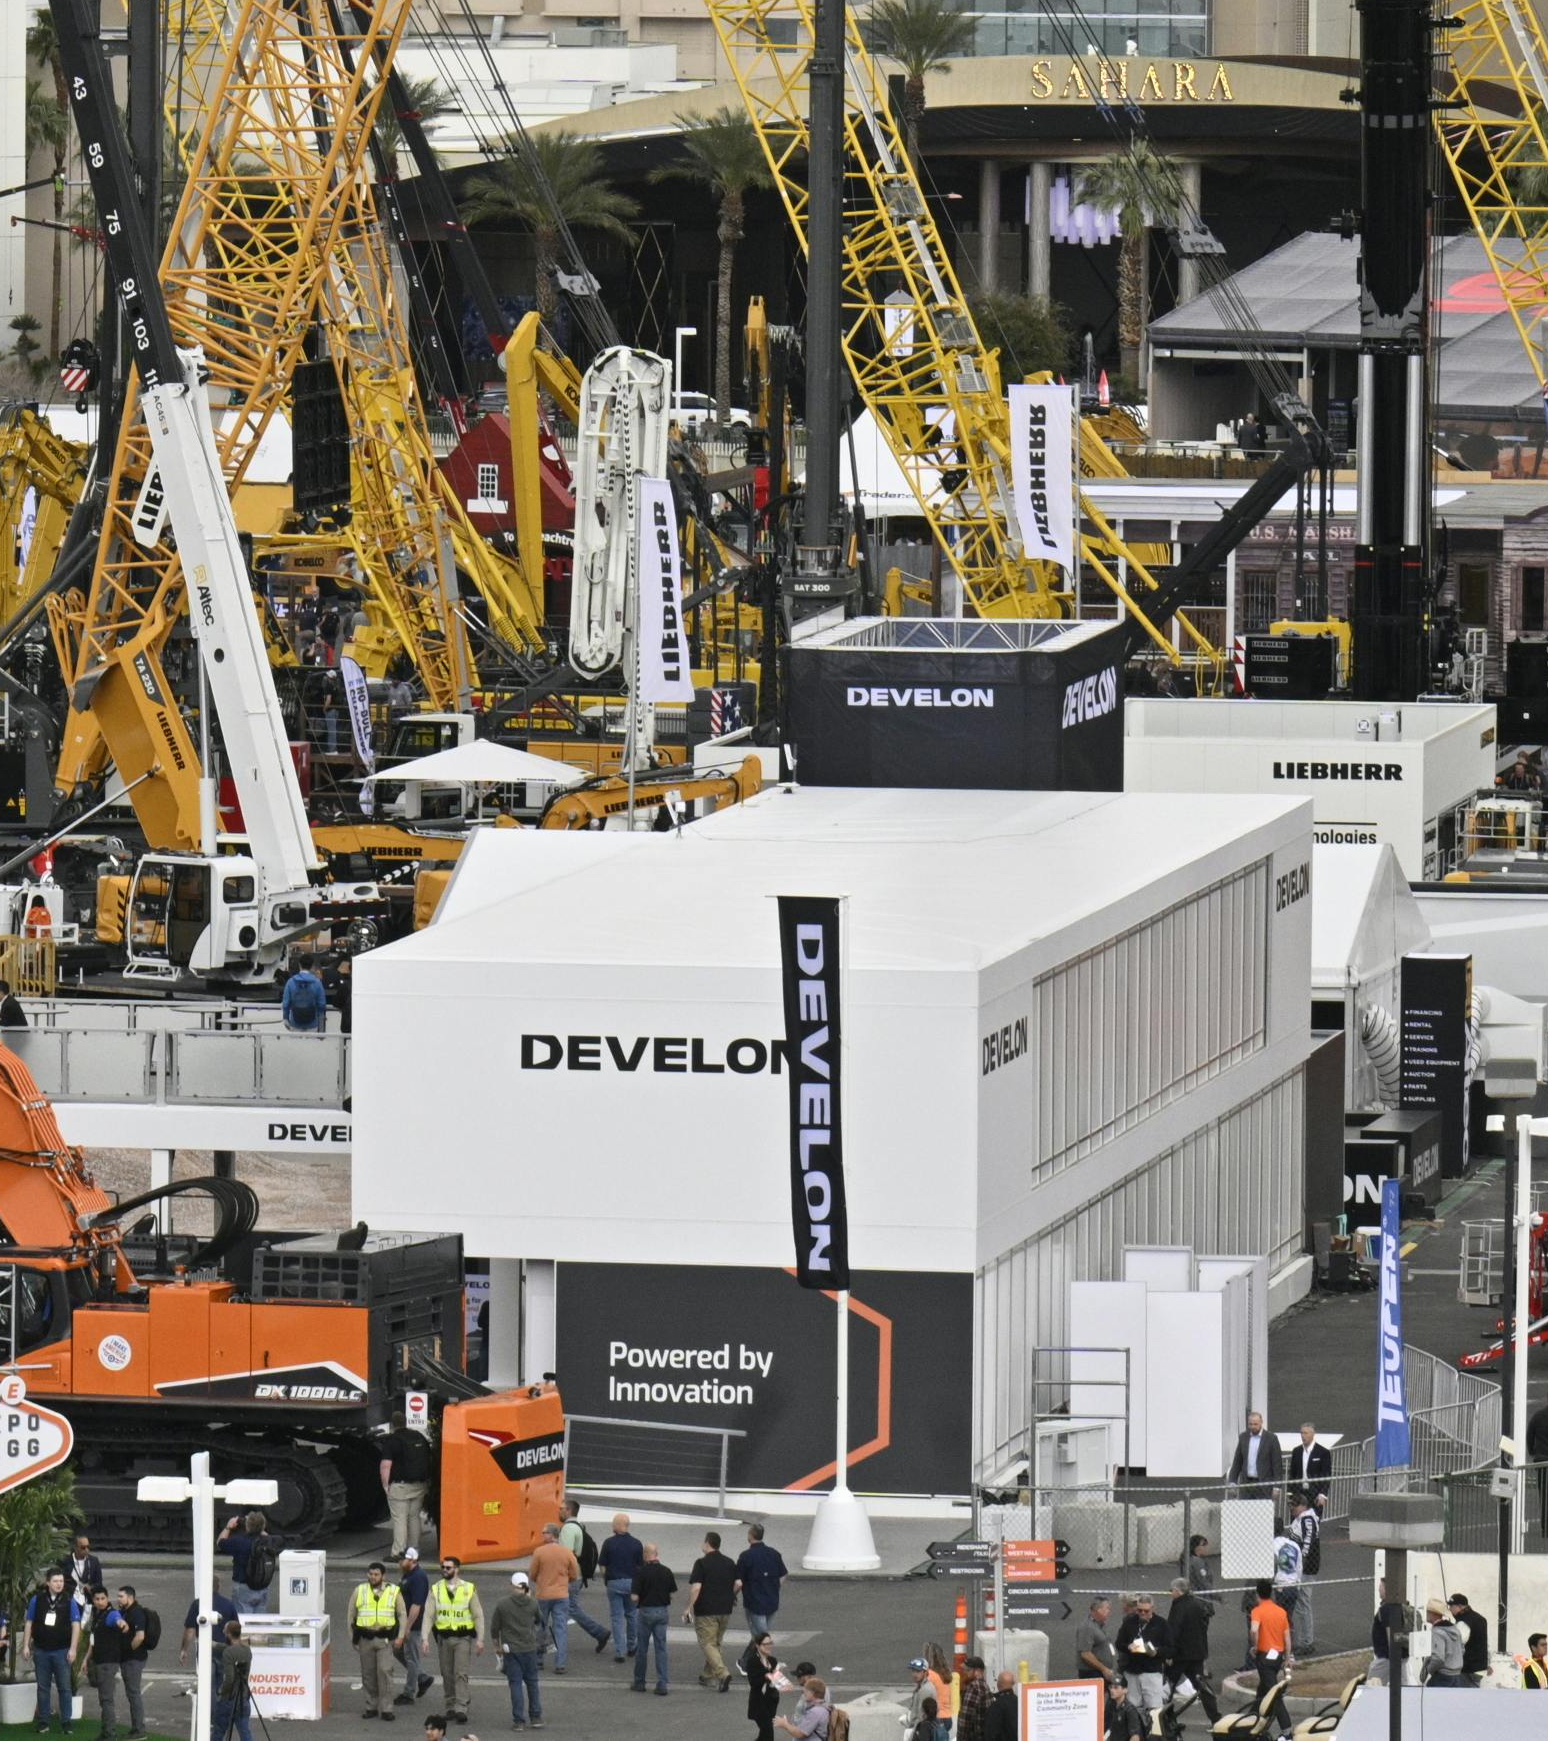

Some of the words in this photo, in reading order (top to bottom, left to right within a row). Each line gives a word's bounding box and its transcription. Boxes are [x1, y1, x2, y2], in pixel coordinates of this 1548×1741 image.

[73, 76, 88, 101] 43
[1031, 60, 1235, 102] SAHARA
[88, 141, 105, 168] 59
[106, 209, 123, 236] 75
[122, 277, 138, 301] 91
[134, 317, 150, 352] 103
[293, 558, 325, 568] KOBELCO
[654, 500, 681, 682] LIEBHERR
[196, 584, 215, 626] Altec
[136, 659, 147, 675] TA
[141, 676, 155, 696] 230
[846, 687, 995, 707] DEVELON
[1062, 666, 1118, 730] DEVELON
[156, 710, 186, 771] LIEBHERR
[1272, 761, 1403, 781] LIEBHERR
[1275, 860, 1310, 912] DEVELON
[1409, 1009, 1443, 1017] FINANCING
[1409, 1021, 1433, 1029] RENTAL
[982, 1015, 1028, 1077] DEVELON
[1409, 1046, 1438, 1054] TRAINING
[1408, 1071, 1436, 1079] AUCTION
[1426, 1059, 1460, 1068] EQUIPMENT
[795, 922, 833, 1272] DEVELON
[1378, 1230, 1407, 1431] TEUPEN
[609, 1341, 731, 1370] Powered
[738, 1342, 774, 1379] by
[609, 1376, 754, 1407] Innovation
[516, 1440, 565, 1470] DEVELON
[249, 1673, 302, 1684] NDUSTRY
[250, 1685, 306, 1696] AGAZINES
